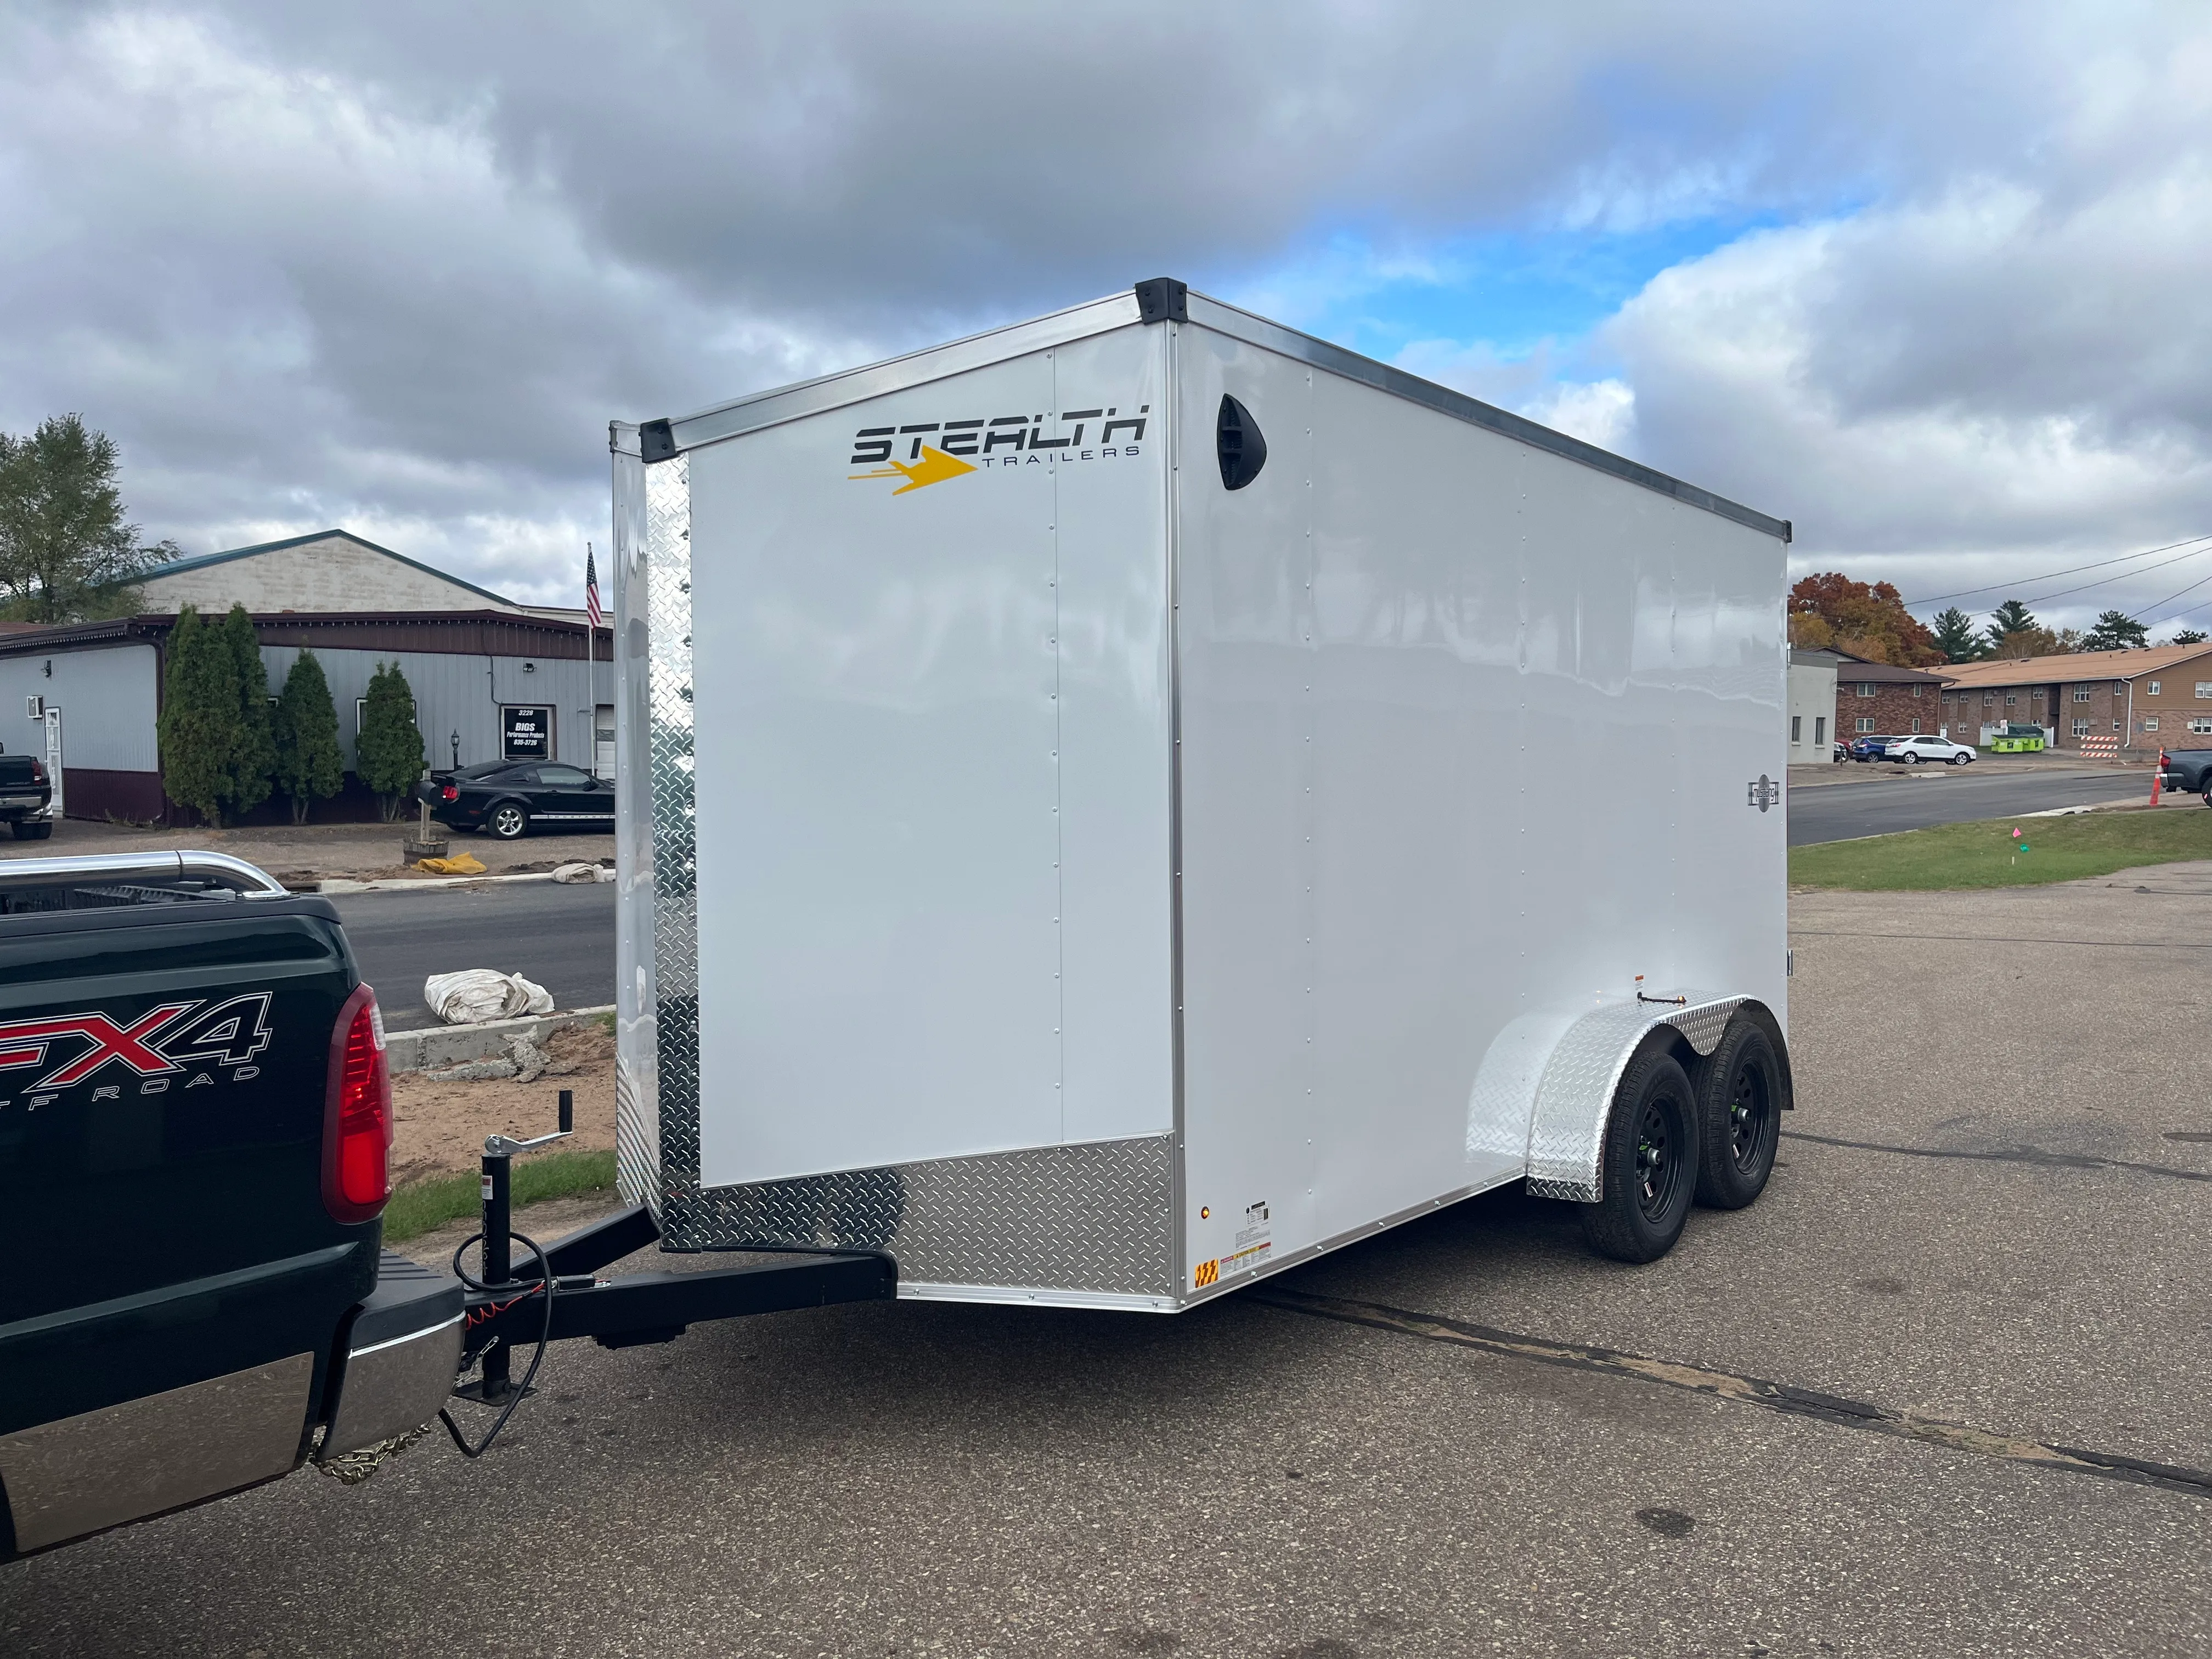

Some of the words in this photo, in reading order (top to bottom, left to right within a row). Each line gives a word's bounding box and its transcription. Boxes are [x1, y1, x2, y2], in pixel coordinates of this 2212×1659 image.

[851, 405, 1149, 464] STEALTH
[982, 446, 1139, 467] TRAILERS
[515, 722, 535, 731] BIGS
[92, 1066, 260, 1102] ROAD
